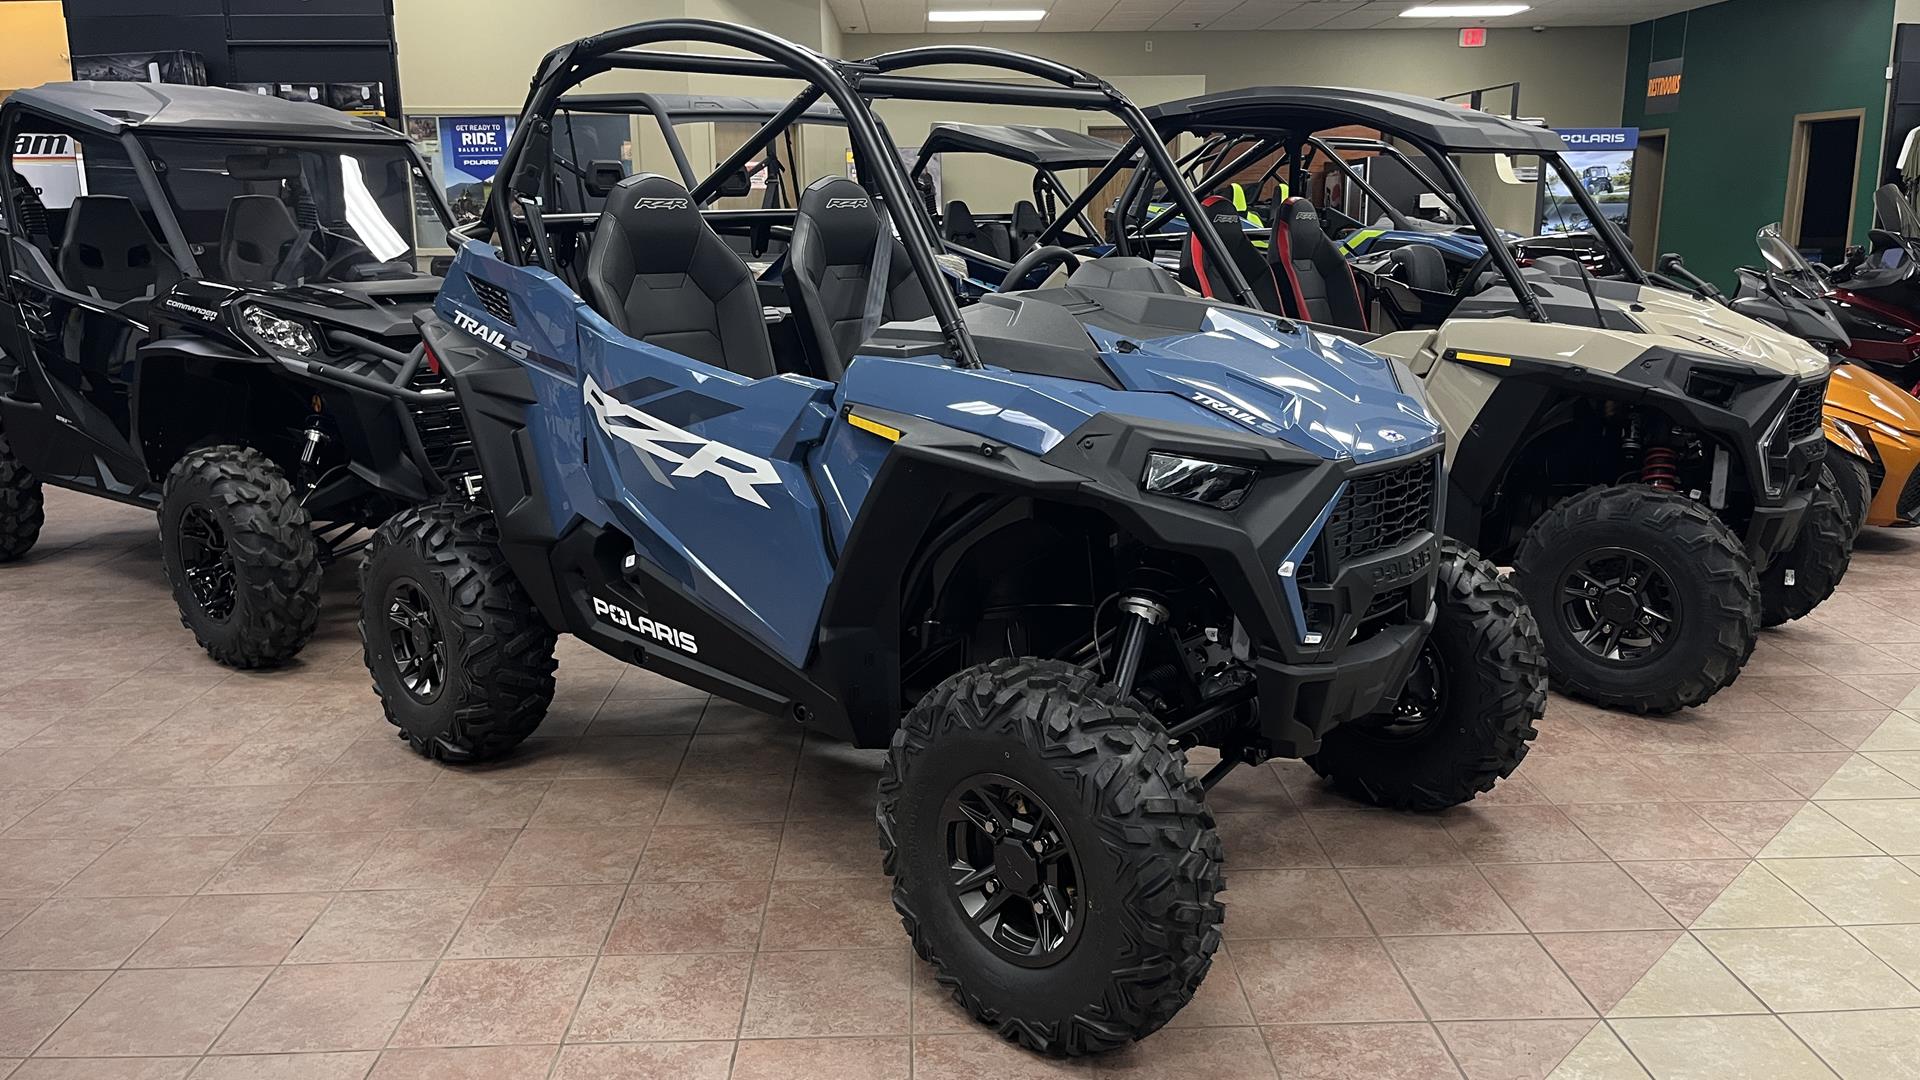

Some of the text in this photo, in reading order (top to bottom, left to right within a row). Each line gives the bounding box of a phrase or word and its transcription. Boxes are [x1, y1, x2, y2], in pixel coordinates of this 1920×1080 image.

[1647, 74, 1681, 97] RESTROOMS
[461, 132, 497, 146] RIDE
[1560, 133, 1625, 143] POLARIS
[634, 197, 688, 210] RZR
[825, 198, 868, 209] RZR
[166, 299, 218, 318] COMMANDER
[453, 309, 532, 360] TRAIL S
[1191, 391, 1282, 434] TRAIL S
[583, 374, 783, 510] RZR
[592, 596, 698, 654] POLARIS
